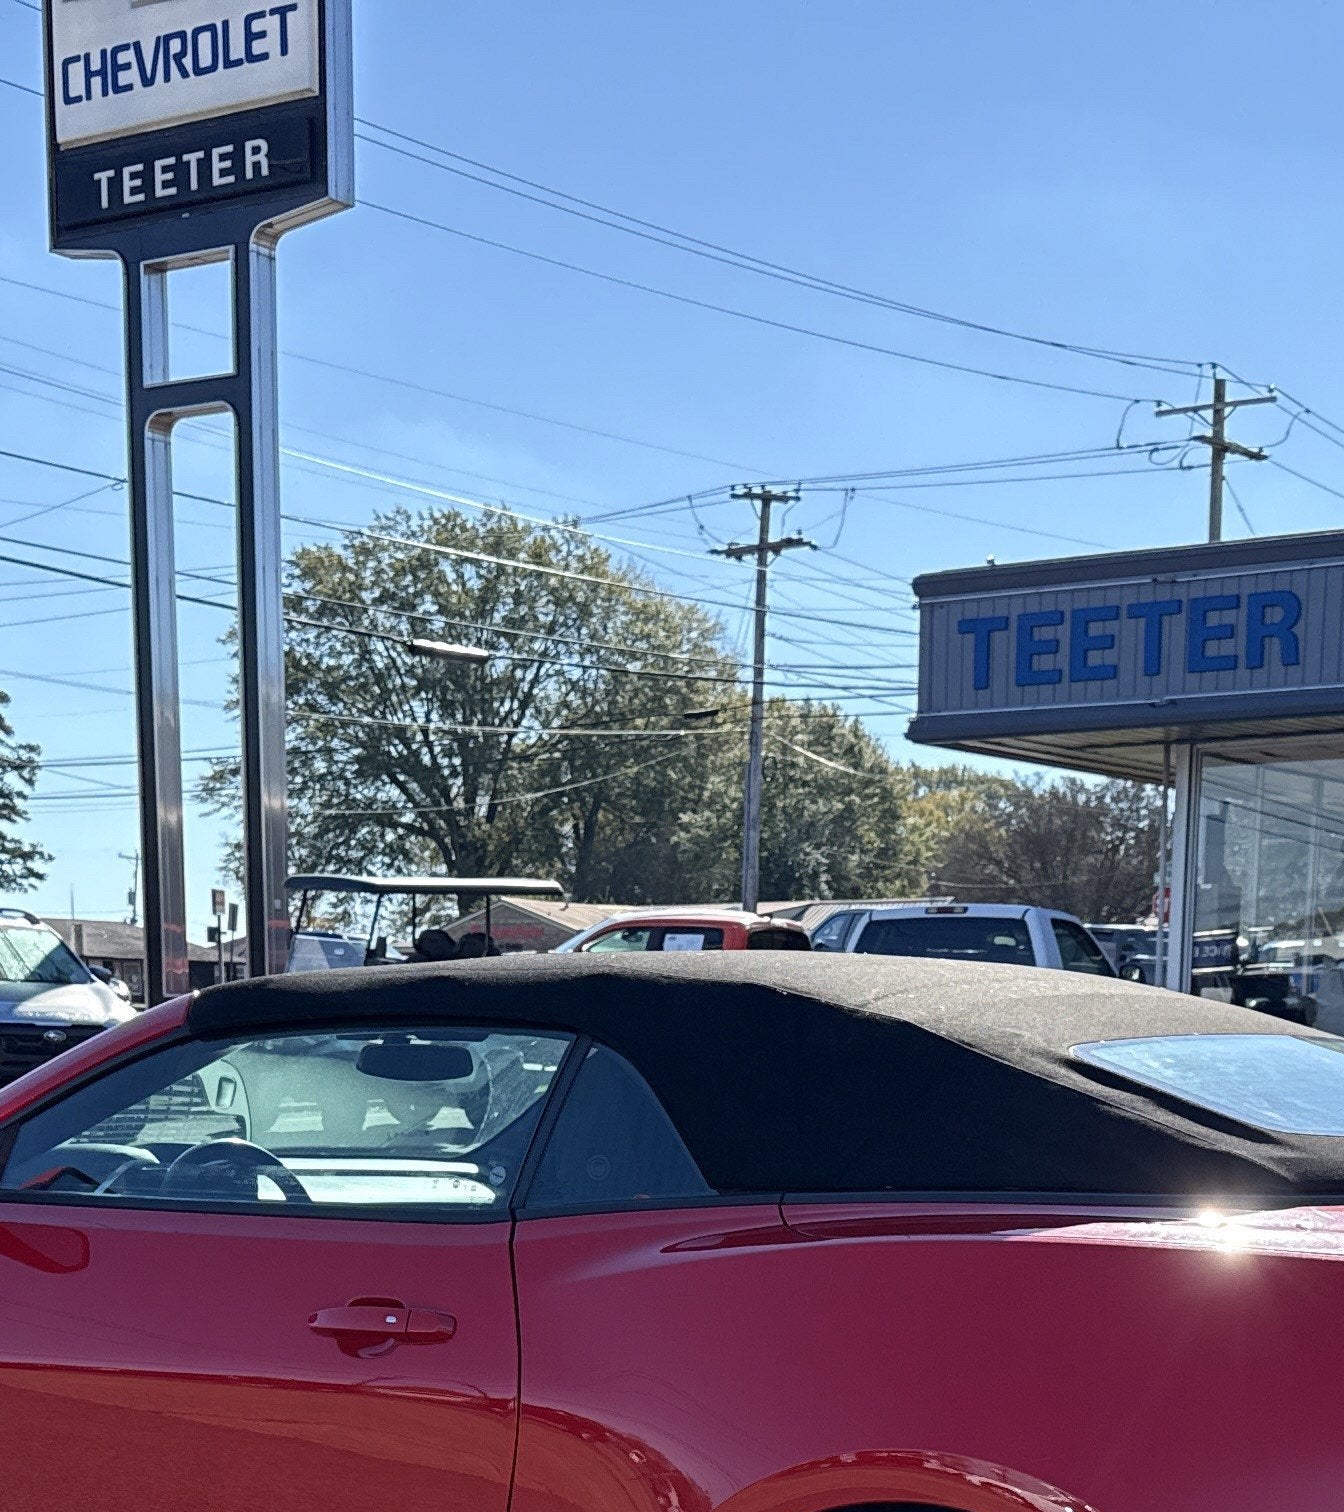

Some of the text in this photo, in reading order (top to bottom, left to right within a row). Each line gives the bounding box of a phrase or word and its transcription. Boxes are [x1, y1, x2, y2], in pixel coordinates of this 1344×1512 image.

[61, 3, 298, 105] CHEVROLET
[94, 138, 270, 209] TEETER
[958, 590, 1303, 690] TEETER
